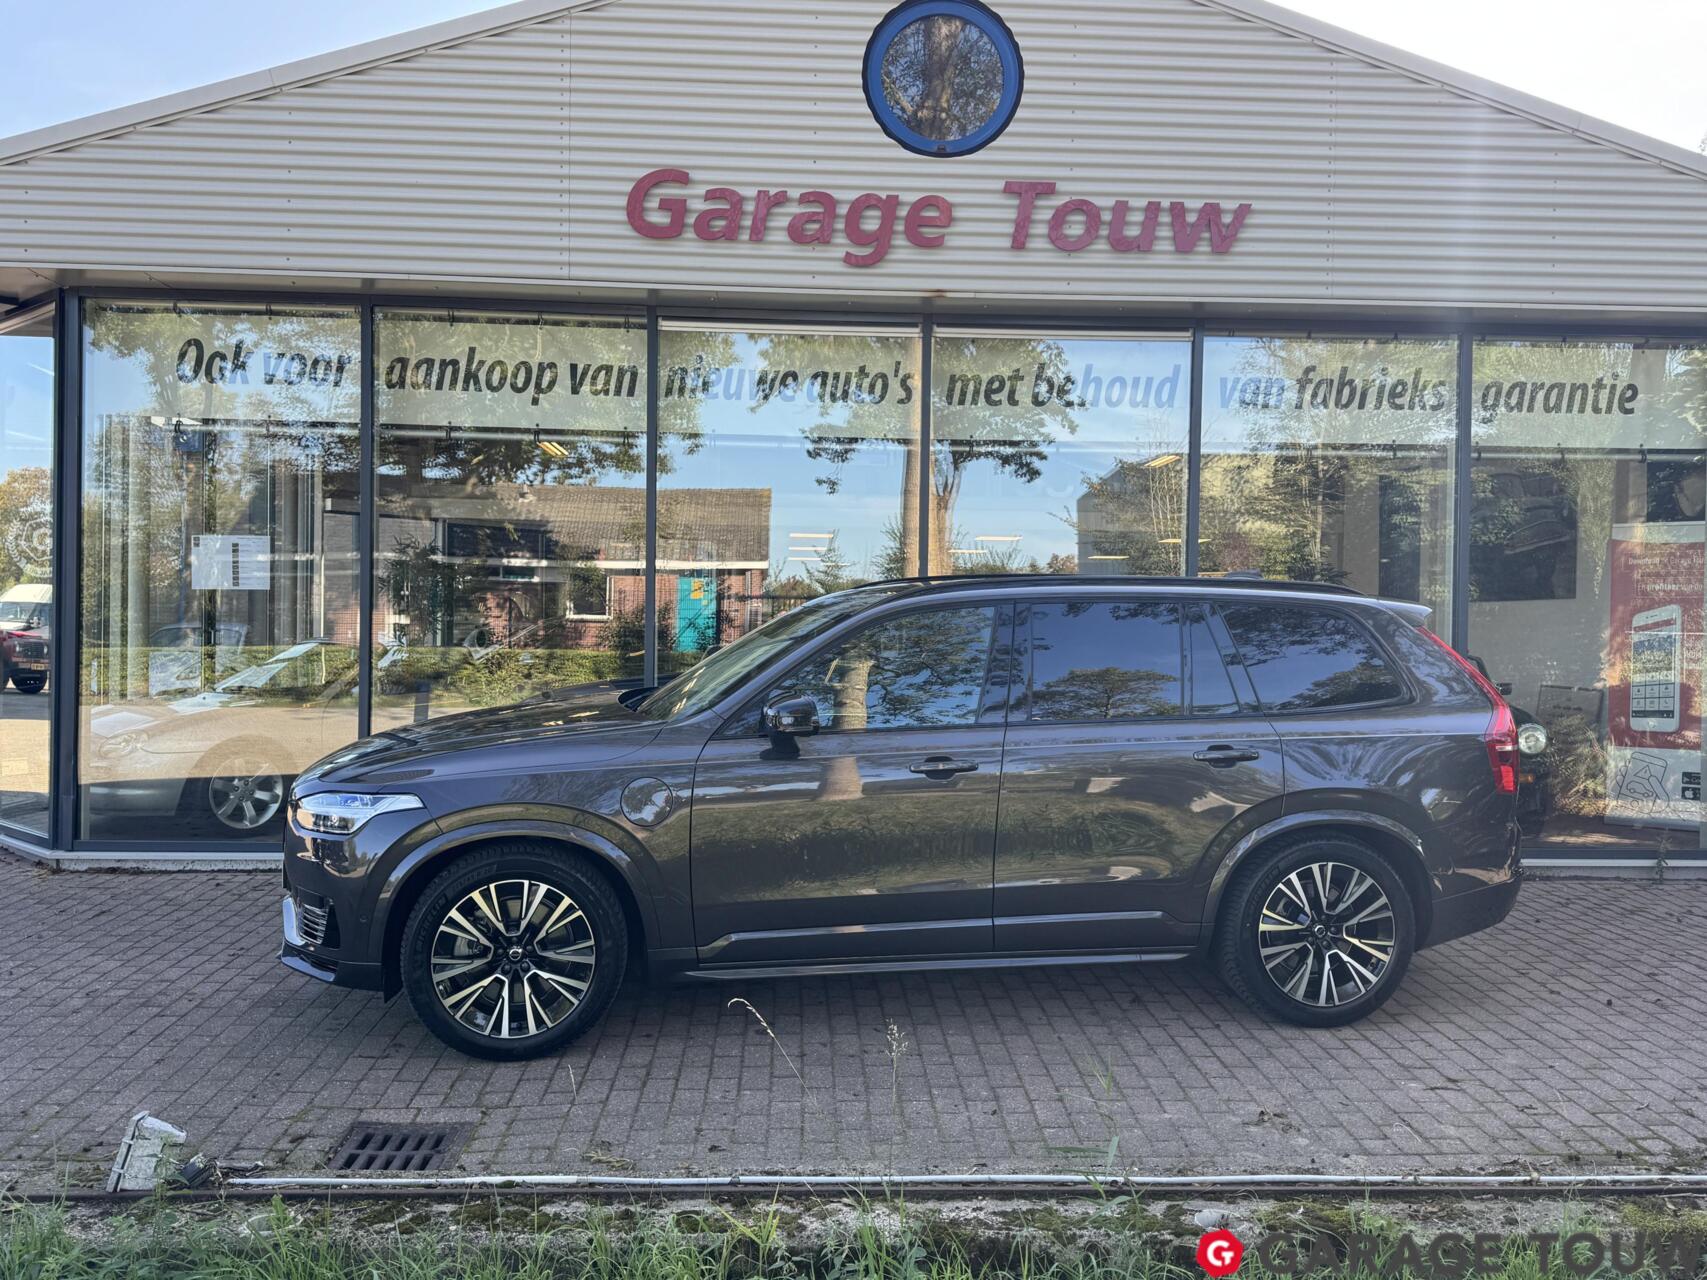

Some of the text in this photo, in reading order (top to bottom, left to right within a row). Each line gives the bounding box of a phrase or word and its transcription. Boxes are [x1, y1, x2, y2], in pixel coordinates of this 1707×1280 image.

[625, 168, 1252, 267] Garage Touw
[176, 338, 1640, 424] Ook voor aankoop van nieuwe auto's met behoud van fabrieks garantie
